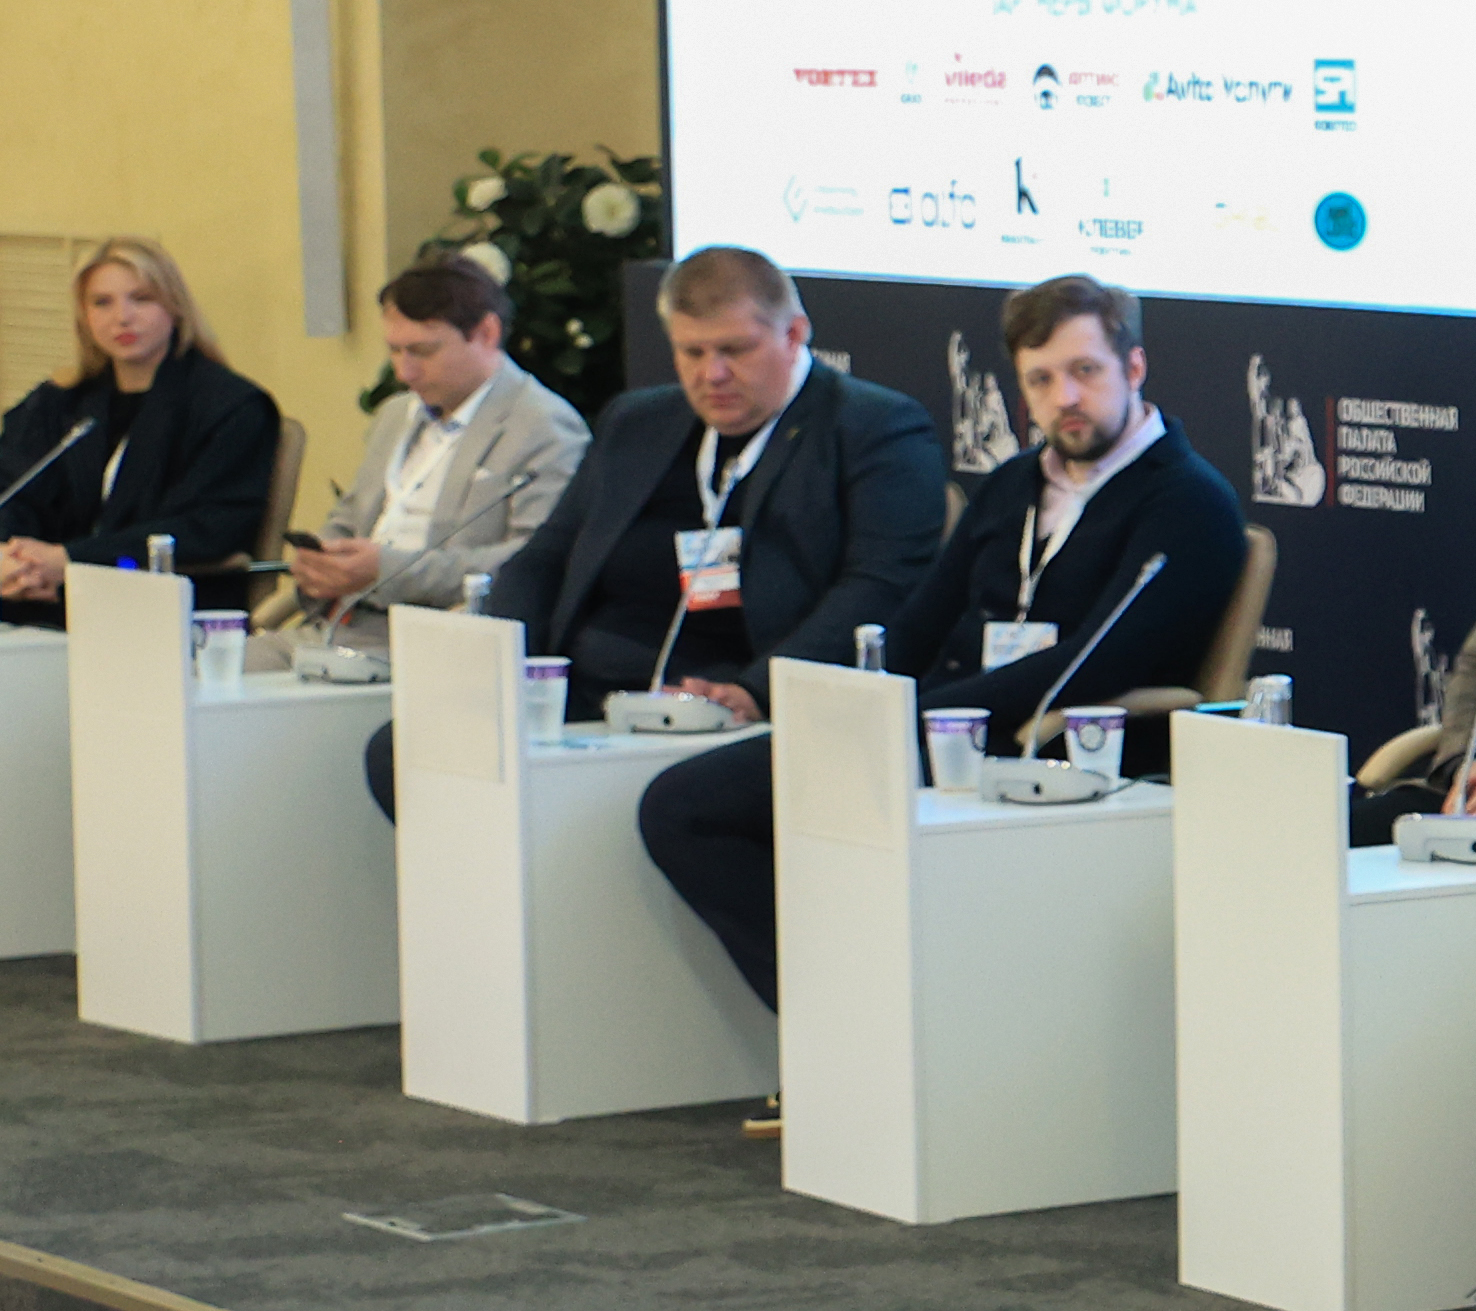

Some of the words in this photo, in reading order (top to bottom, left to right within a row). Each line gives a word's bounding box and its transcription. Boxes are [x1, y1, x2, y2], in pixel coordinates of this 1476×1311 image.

[1337, 396, 1459, 431] ОБЩЕСТВЕННАЯ
[1337, 424, 1397, 455] ПАЛАТА
[1337, 454, 1432, 487] РОССИЙСКОЙ
[1337, 483, 1425, 514] ФЕДЕРАЦИИ
